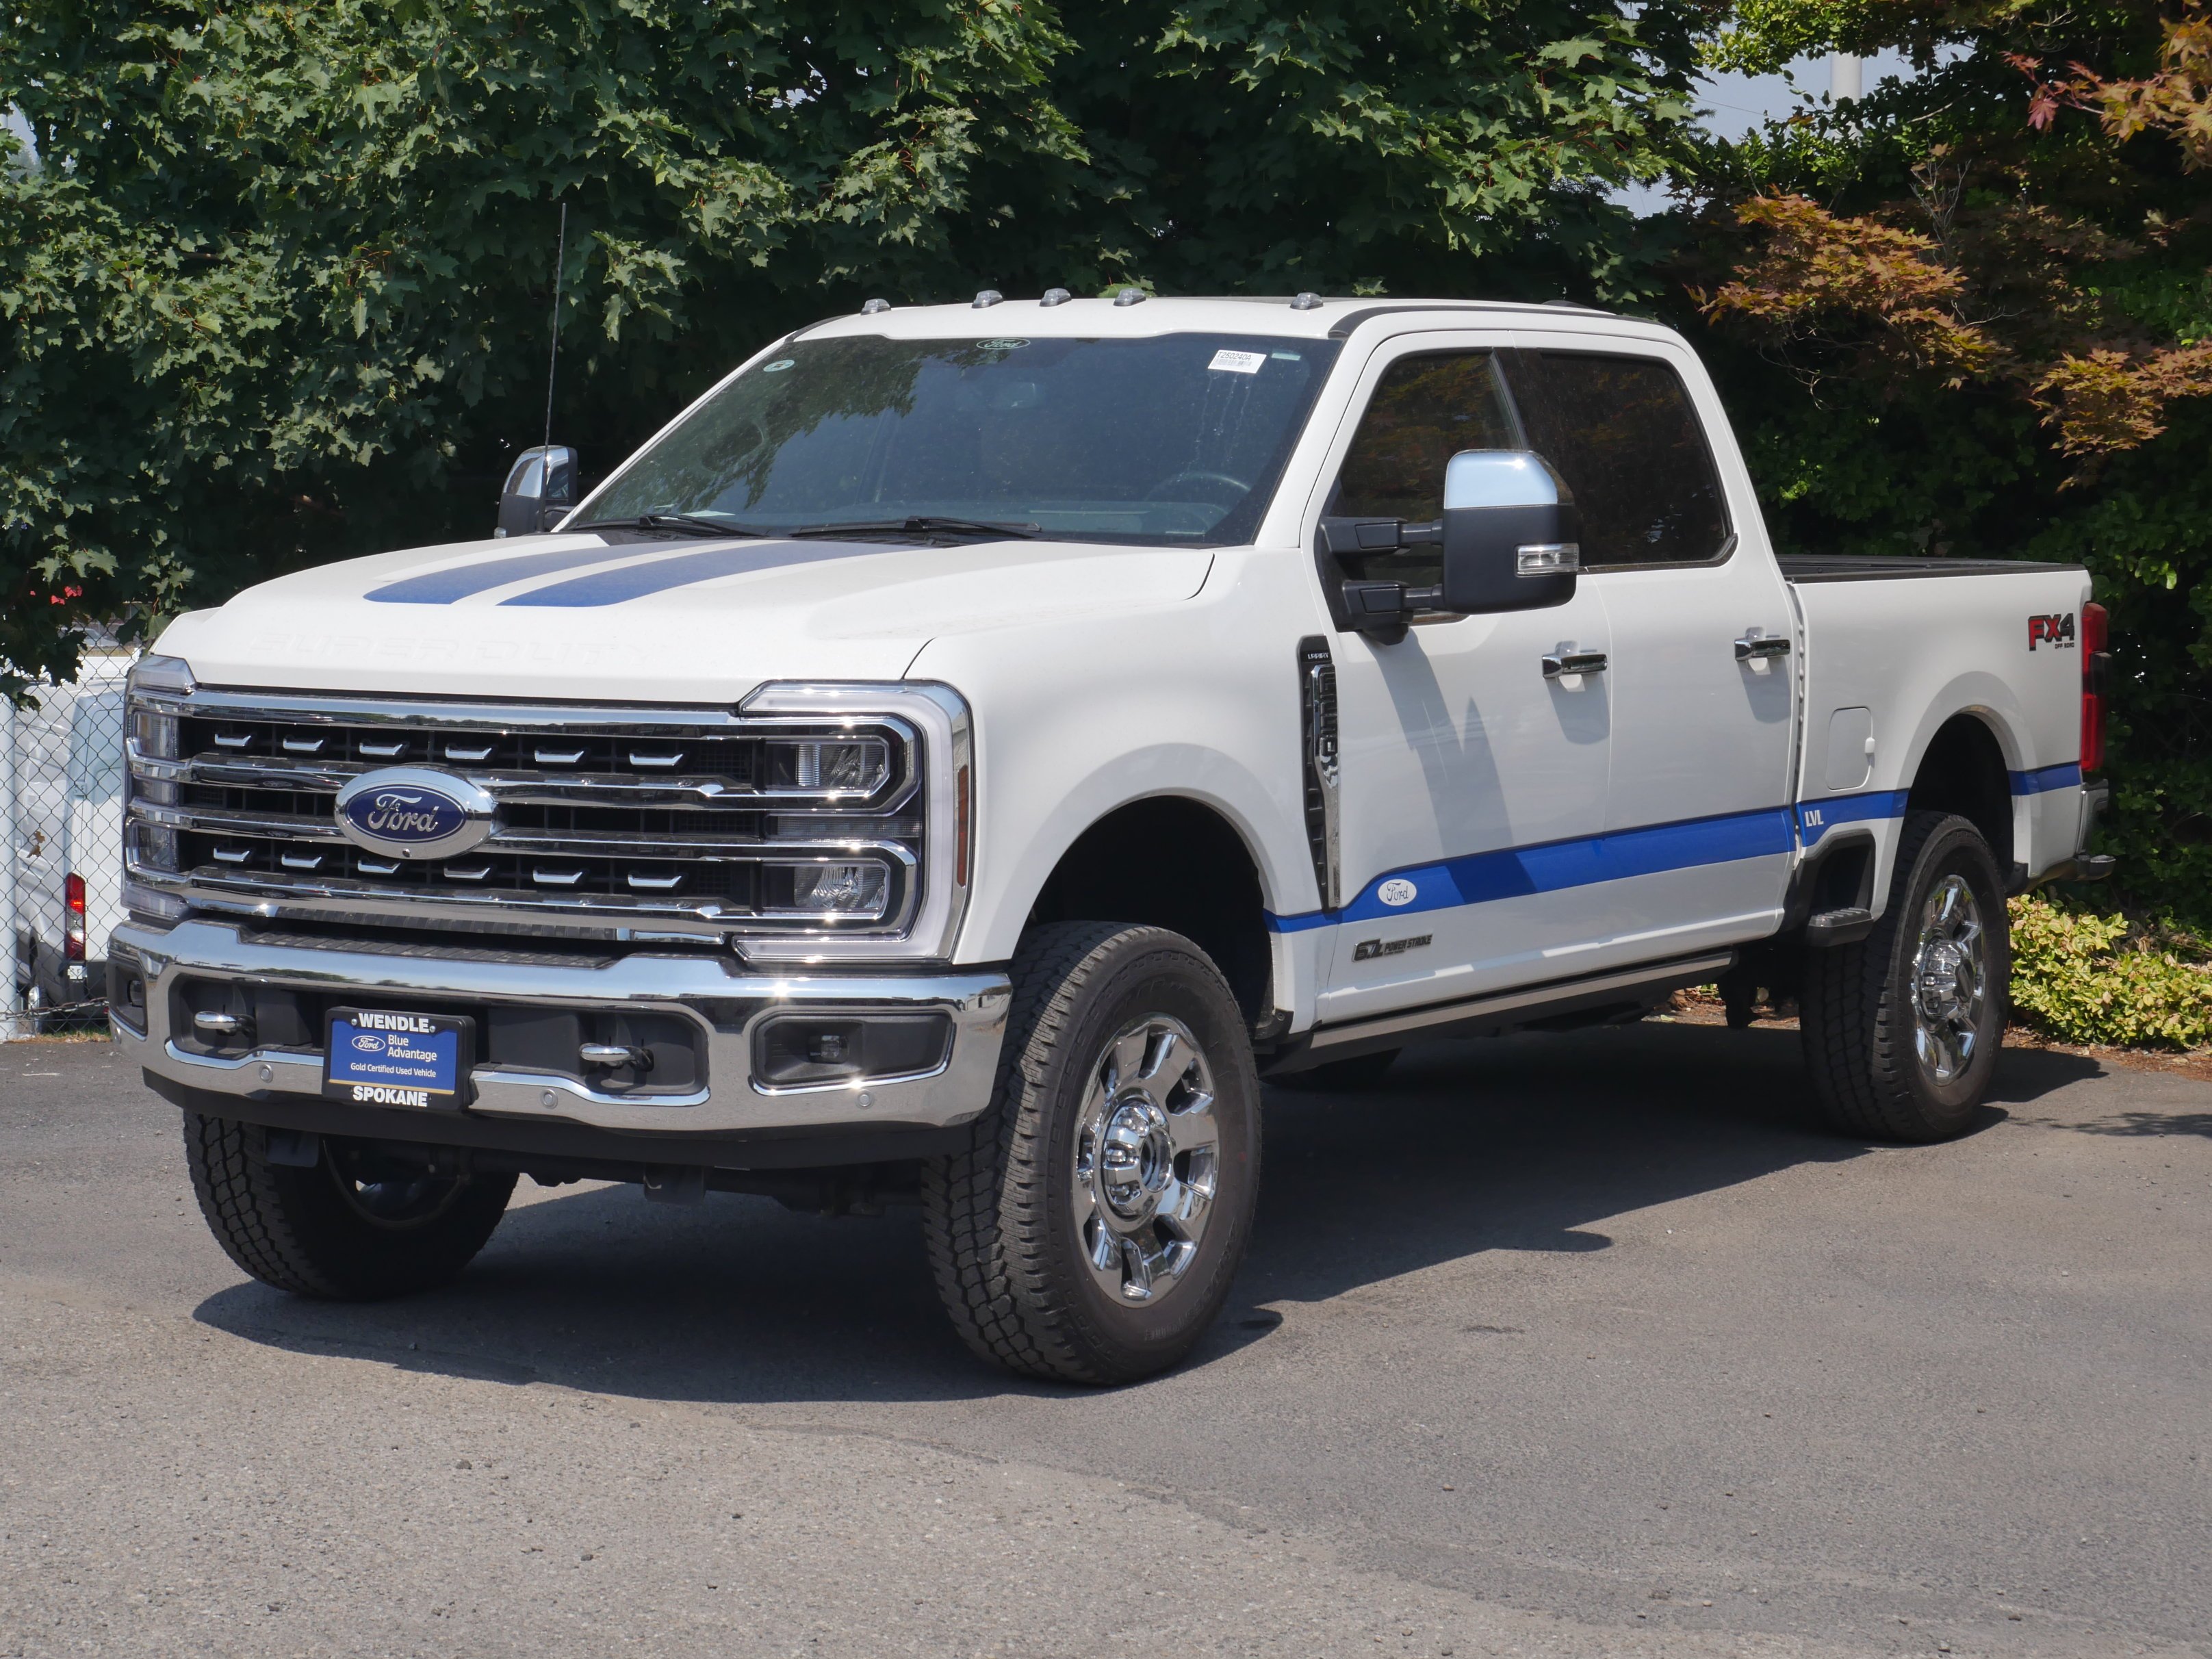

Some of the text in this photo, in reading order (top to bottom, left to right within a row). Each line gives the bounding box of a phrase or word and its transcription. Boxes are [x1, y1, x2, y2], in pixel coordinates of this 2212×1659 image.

[984, 339, 1022, 348] Ford
[1218, 351, 1251, 361] T250240A
[2028, 613, 2074, 652] FX4
[368, 793, 439, 832] Ford
[1805, 810, 1824, 827] LVL
[1386, 882, 1409, 901] Ford
[358, 1012, 430, 1033] WENDLE
[358, 1038, 379, 1050] Ford
[388, 1035, 409, 1046] Blue
[387, 1046, 437, 1062] Advantage
[350, 1062, 437, 1077] Gold Certified Used Vehicle
[352, 1085, 428, 1107] SPOKANE
